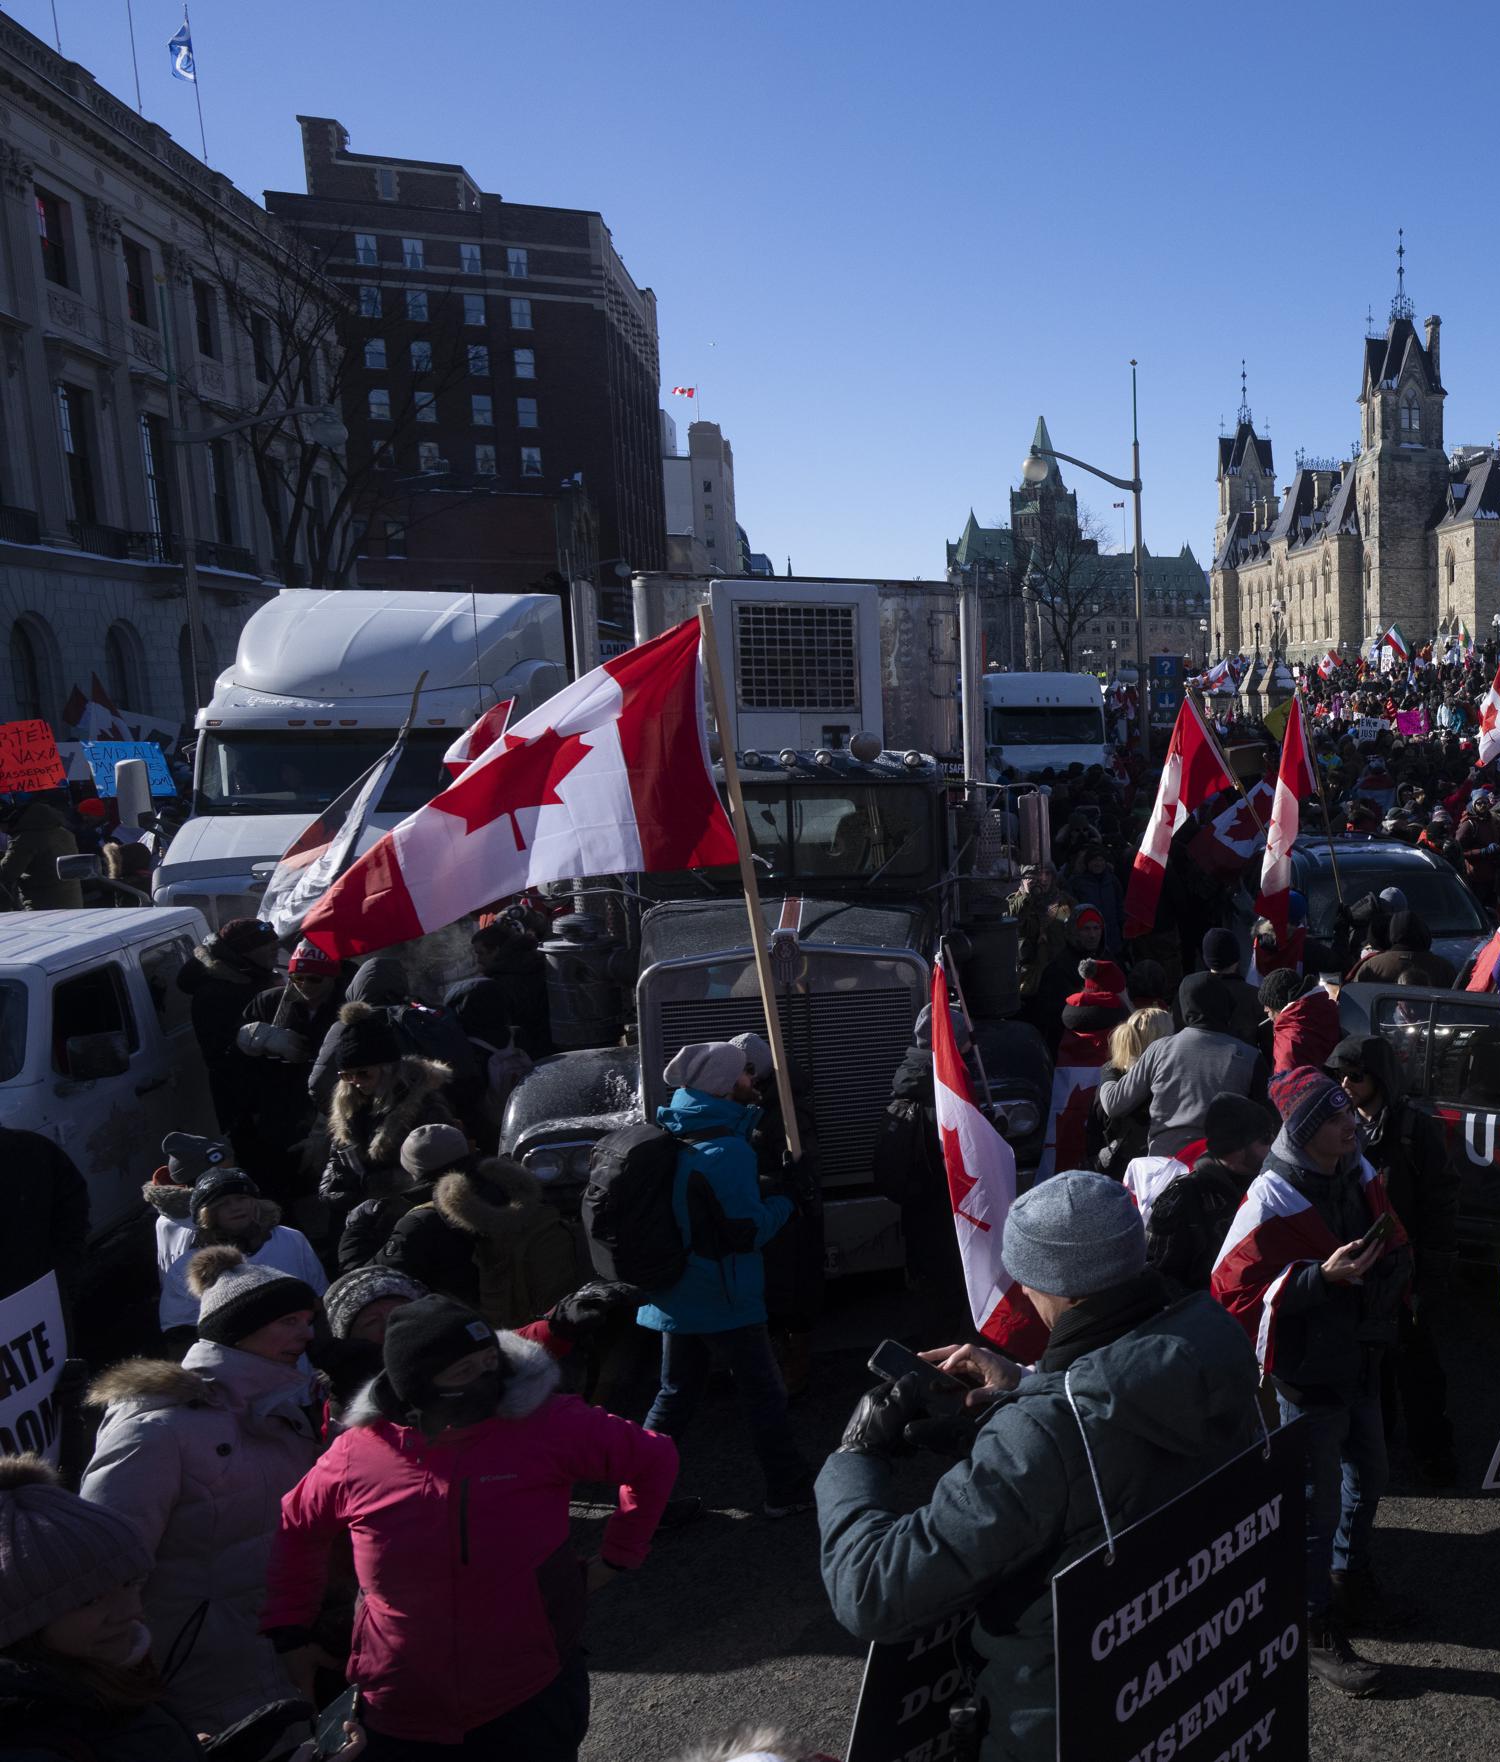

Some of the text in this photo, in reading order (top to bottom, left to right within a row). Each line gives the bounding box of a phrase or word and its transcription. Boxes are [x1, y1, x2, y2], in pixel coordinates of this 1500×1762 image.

[1090, 1493, 1284, 1662] CHILDREN
[1114, 1576, 1267, 1723] CANNOT
[1259, 1623, 1300, 1680] TO
